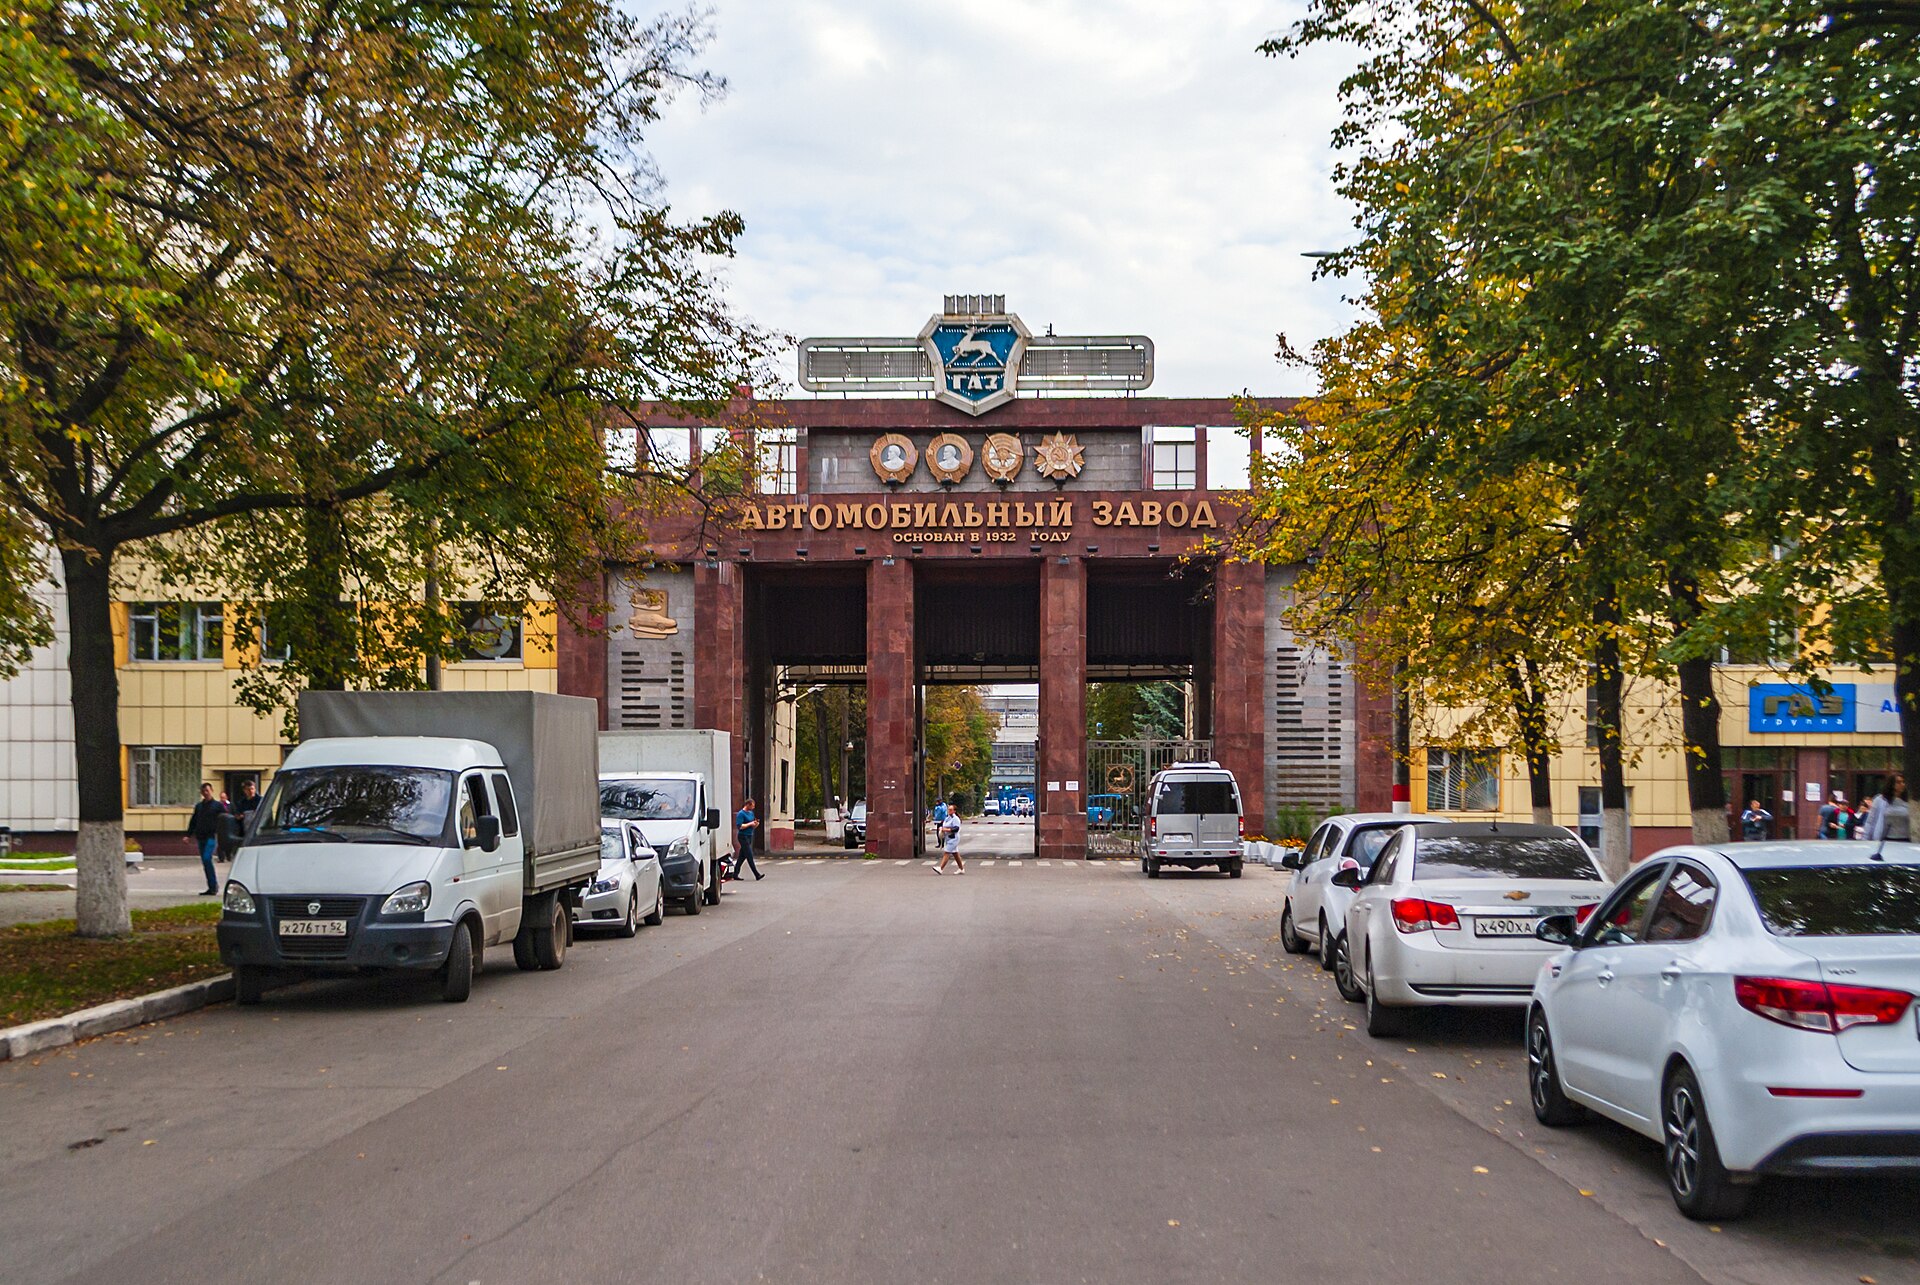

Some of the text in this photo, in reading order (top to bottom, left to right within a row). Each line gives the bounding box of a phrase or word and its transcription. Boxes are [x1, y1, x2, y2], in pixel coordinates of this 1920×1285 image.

[952, 374, 998, 390] ГАЗ
[742, 497, 1218, 531] АВТОМОБИЛЬНЫЙ ЗАВОД
[893, 531, 1071, 543] ОСНОВАН В 1932 ГОДУ
